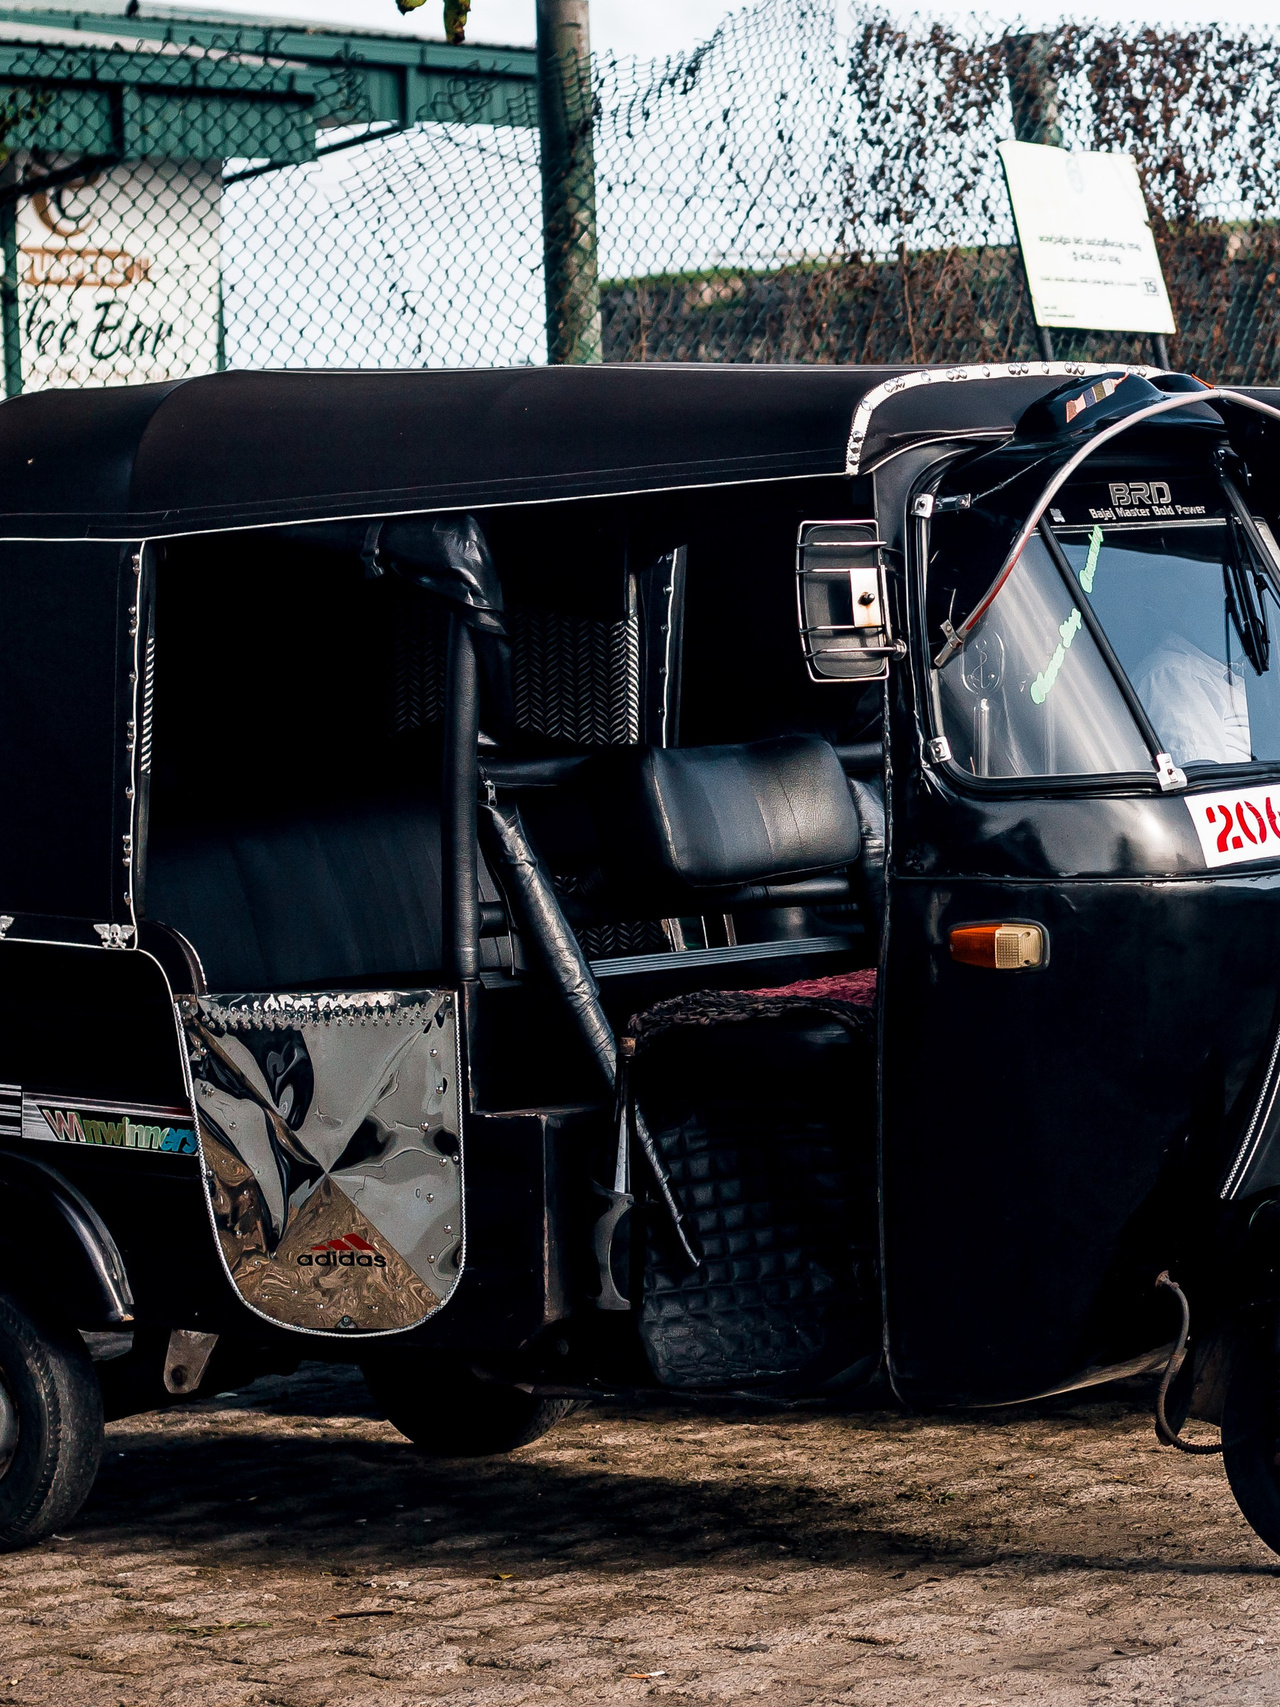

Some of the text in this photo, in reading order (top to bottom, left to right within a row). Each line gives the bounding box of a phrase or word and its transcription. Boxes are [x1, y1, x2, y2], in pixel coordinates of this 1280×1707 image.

[1108, 481, 1172, 506] BRD
[1088, 504, 1206, 521] Bajaj Master Bold Power
[41, 1108, 198, 1155] Winwinners
[296, 1251, 387, 1268] adidas
